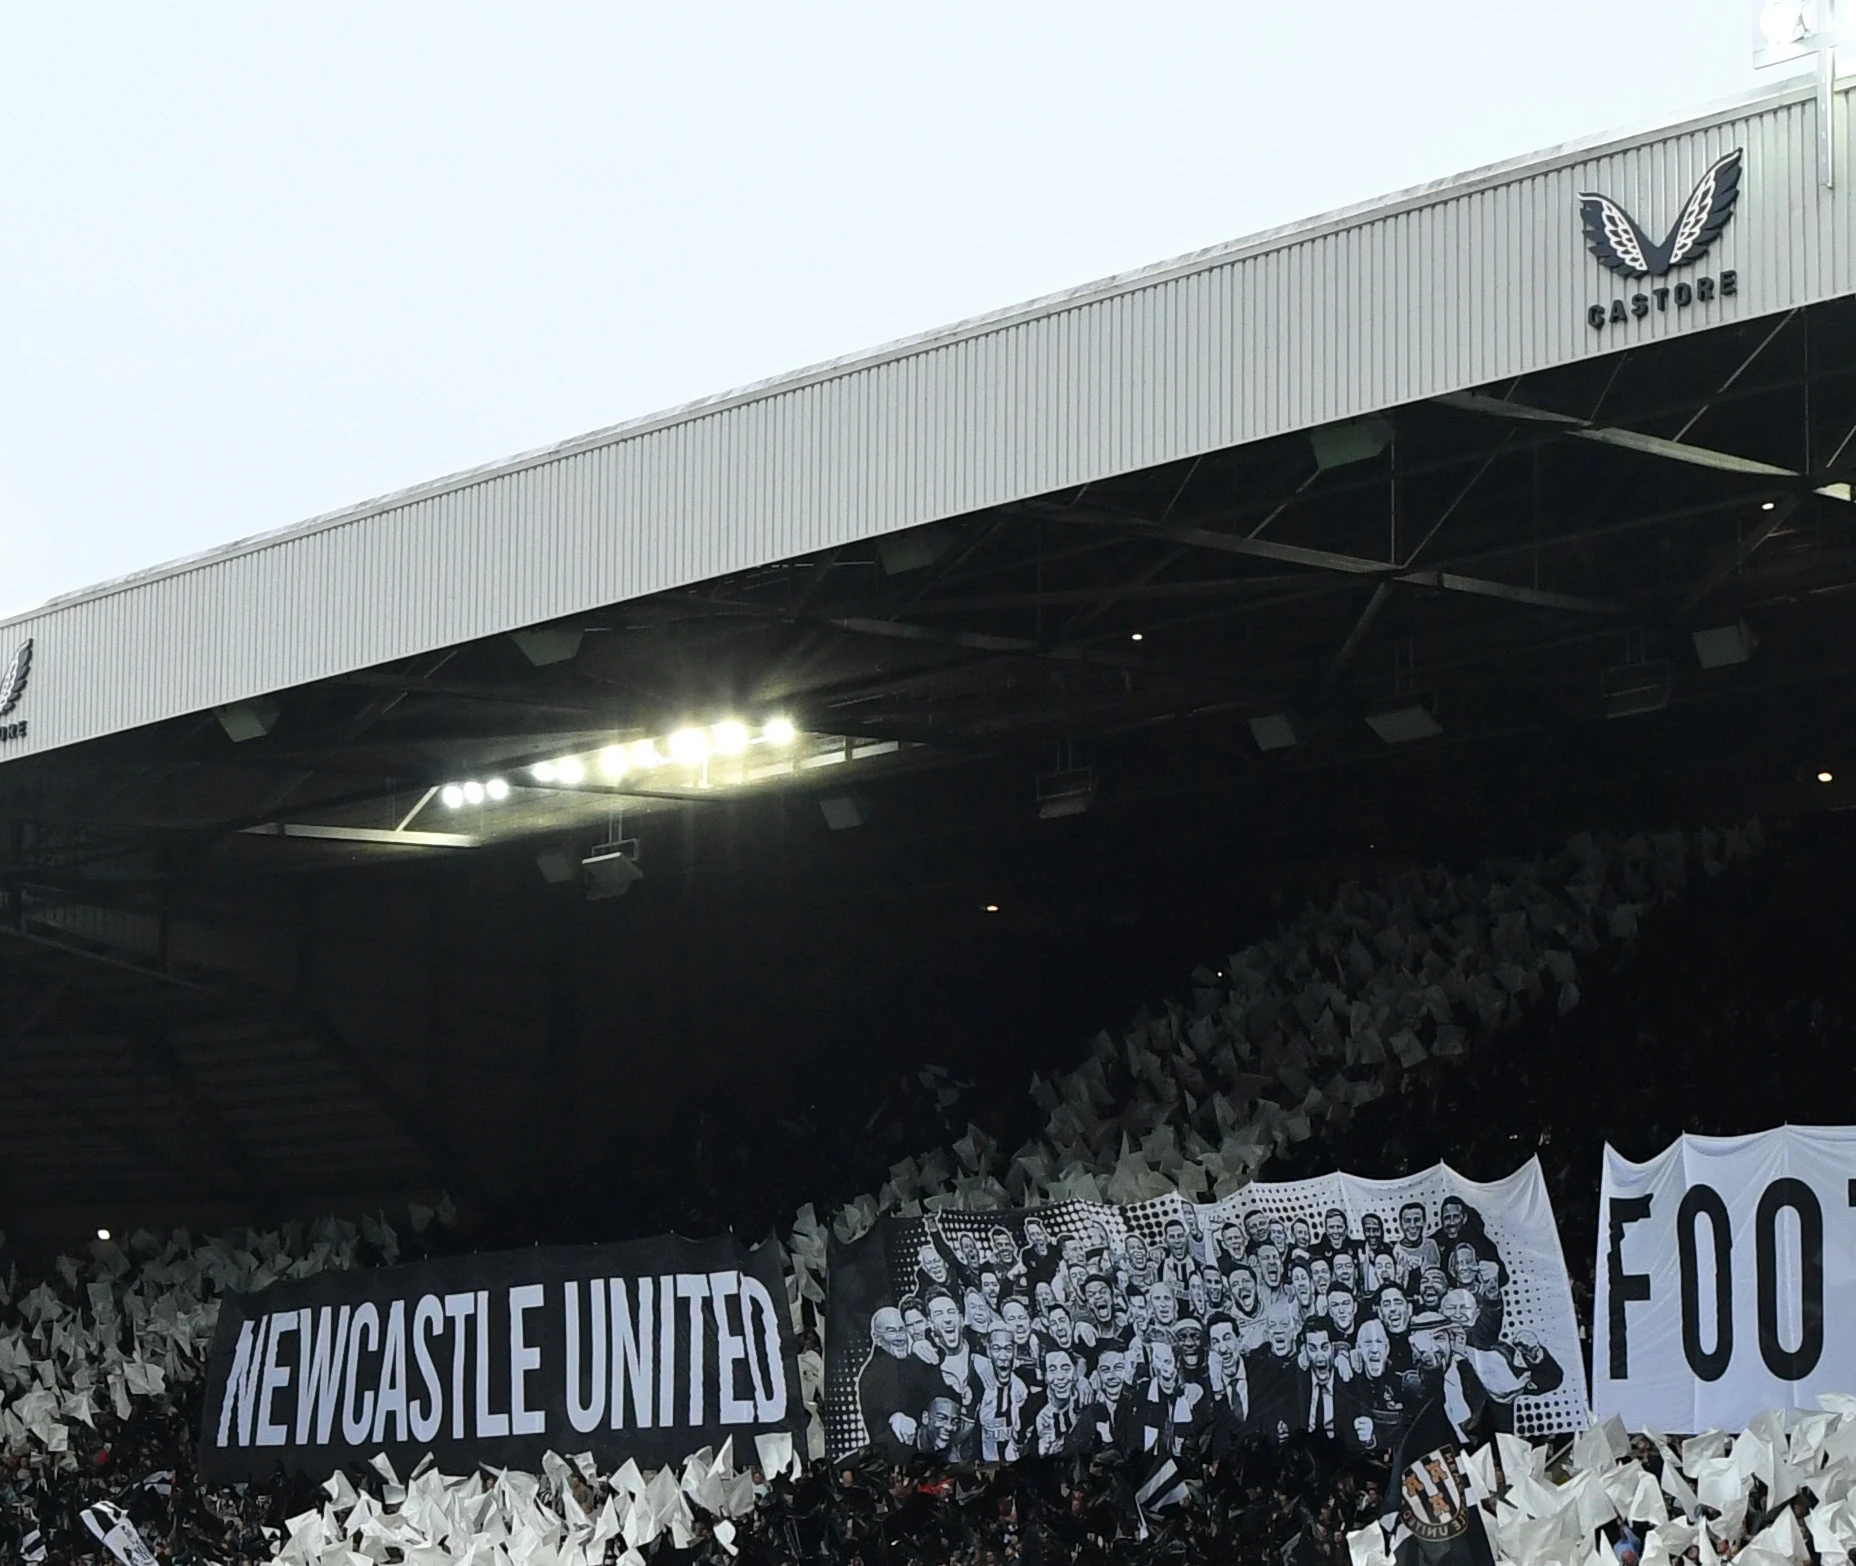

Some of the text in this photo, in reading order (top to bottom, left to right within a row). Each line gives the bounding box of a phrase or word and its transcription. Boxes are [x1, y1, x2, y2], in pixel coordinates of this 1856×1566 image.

[1588, 269, 1738, 331] CASTORE
[216, 1270, 787, 1448] NEWCASTLE UNITED
